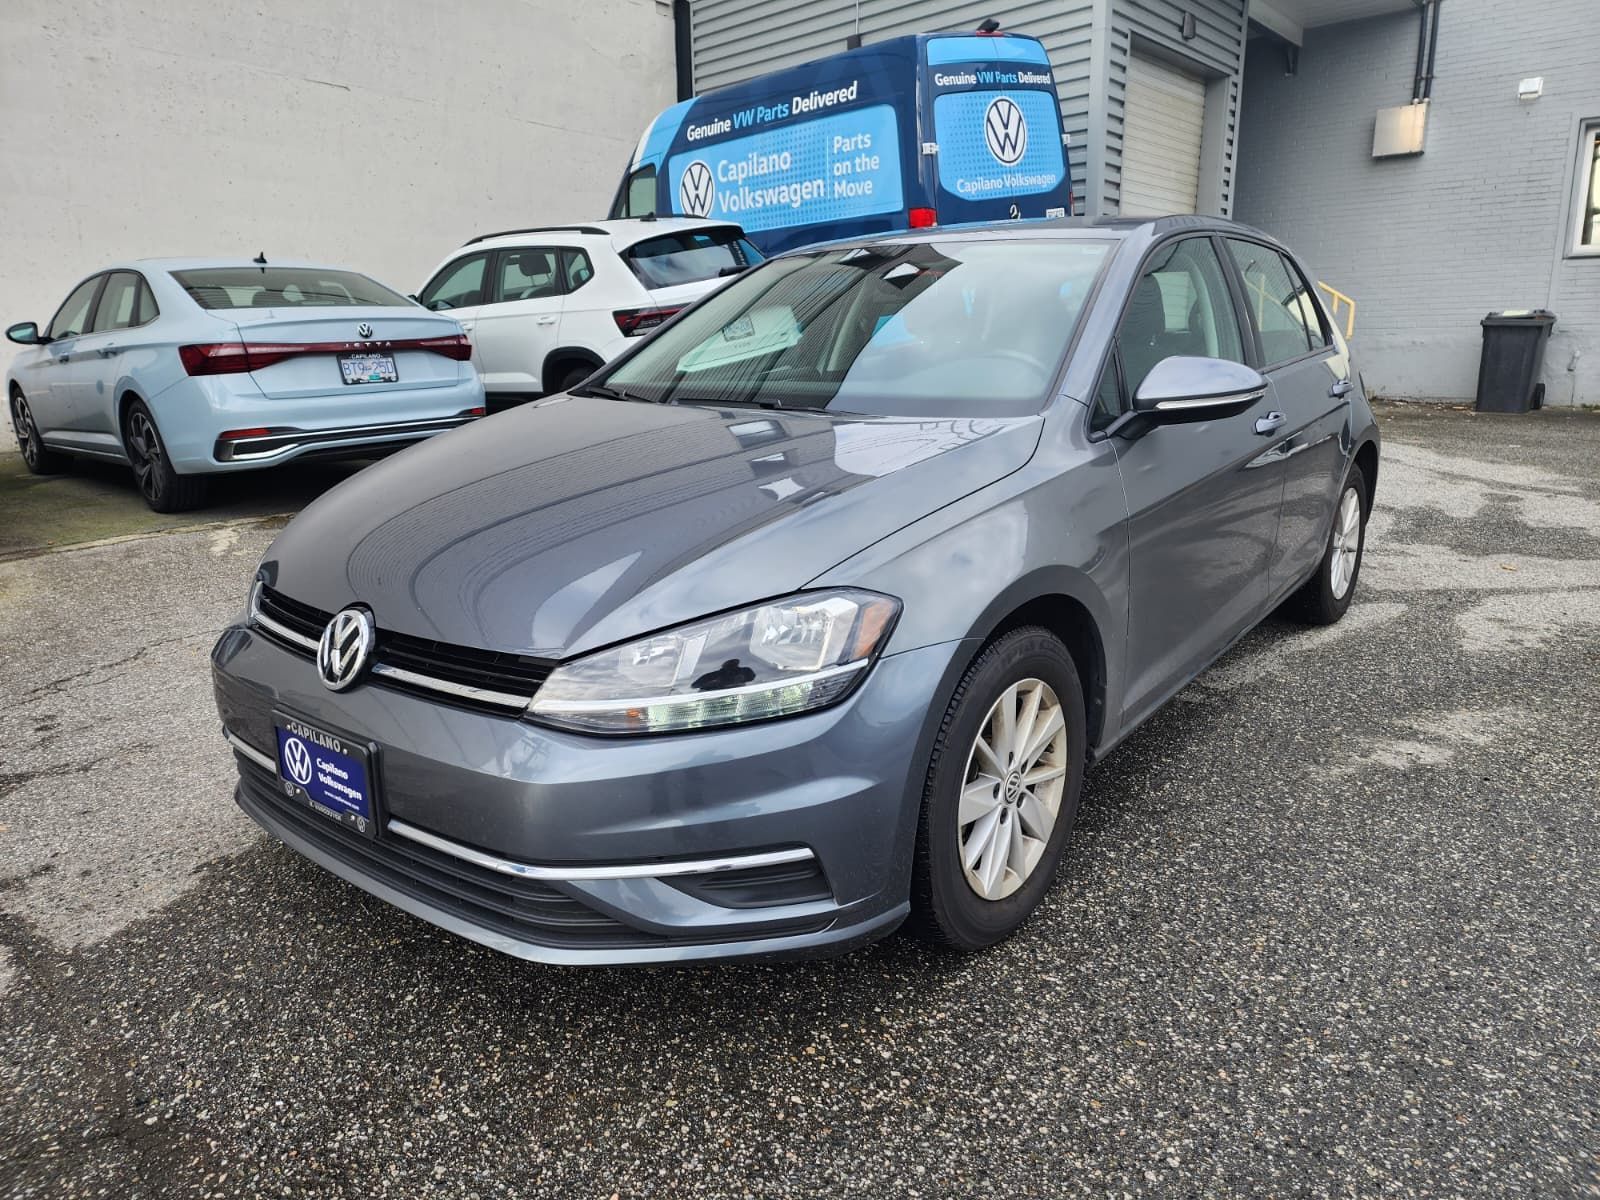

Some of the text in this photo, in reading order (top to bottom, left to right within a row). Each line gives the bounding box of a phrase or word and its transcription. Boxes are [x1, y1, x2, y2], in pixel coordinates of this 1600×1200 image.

[935, 71, 1051, 86] Genuine VW Parts Delivered
[687, 80, 858, 141] Genuine VW Parts Delivered
[833, 132, 872, 154] Parts
[717, 150, 792, 184] Capilano
[833, 153, 880, 176] on the
[717, 177, 825, 213] Volkswagen
[833, 179, 873, 199] Move
[956, 173, 1056, 194] Capilano Volkswagen
[290, 722, 341, 753] CAPILANO
[316, 758, 349, 780] Capilano
[318, 771, 362, 801] Volkswagen
